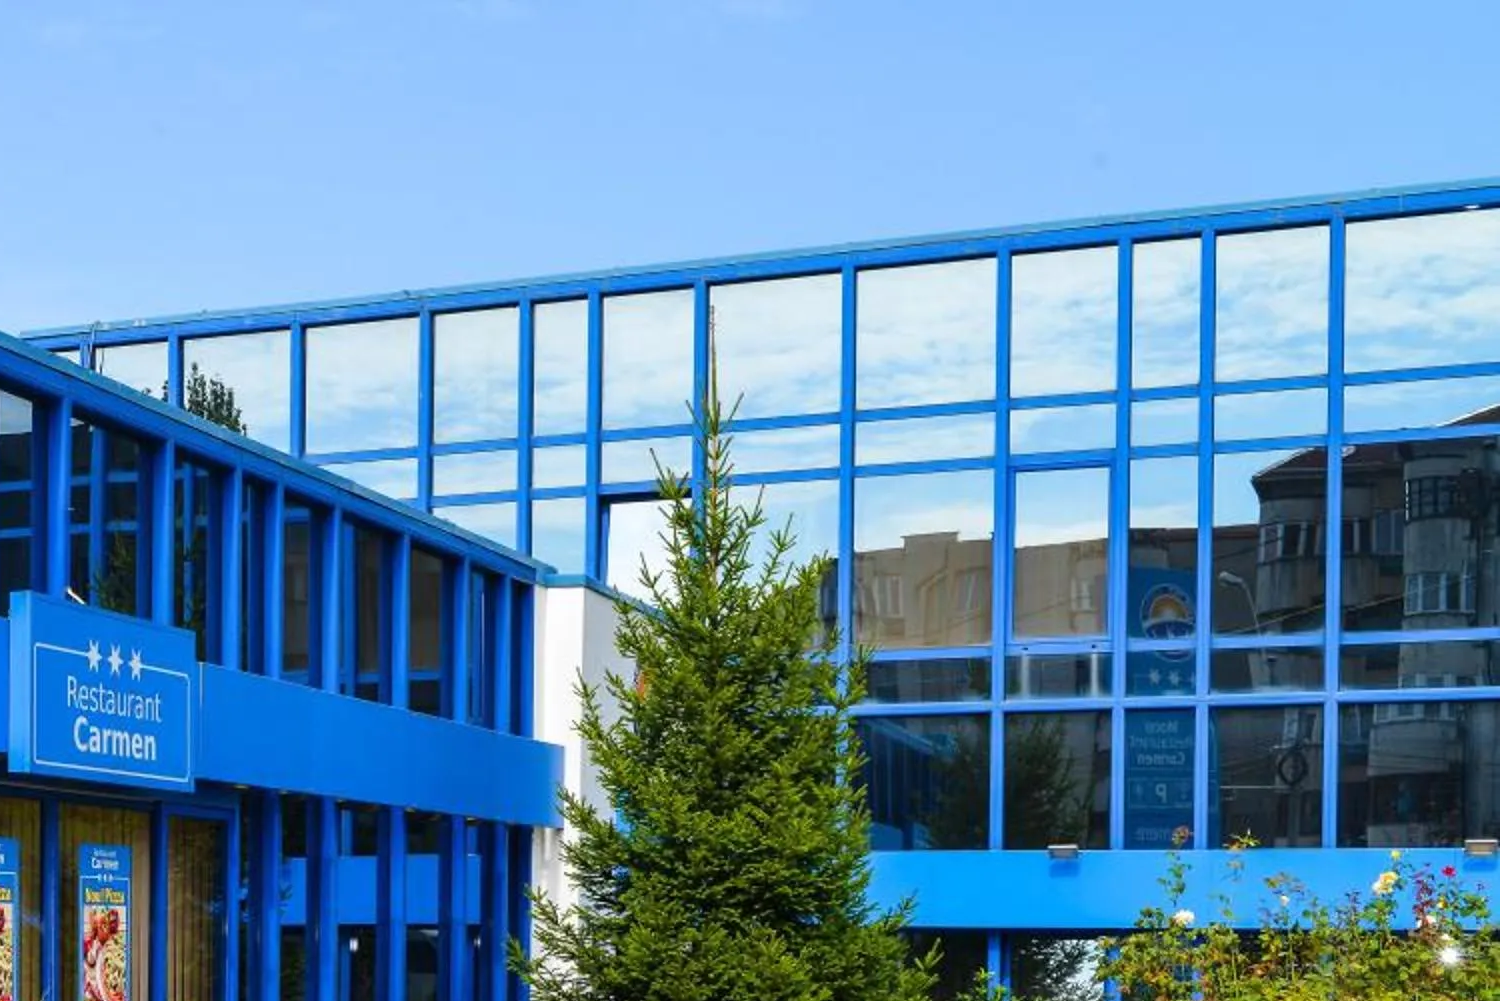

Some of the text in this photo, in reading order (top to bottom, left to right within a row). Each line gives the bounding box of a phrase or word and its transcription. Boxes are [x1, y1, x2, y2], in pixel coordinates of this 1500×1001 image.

[67, 674, 162, 723] Restaurant
[73, 715, 157, 761] Carmen
[91, 857, 120, 871] Carmen
[106, 888, 125, 904] Pizza
